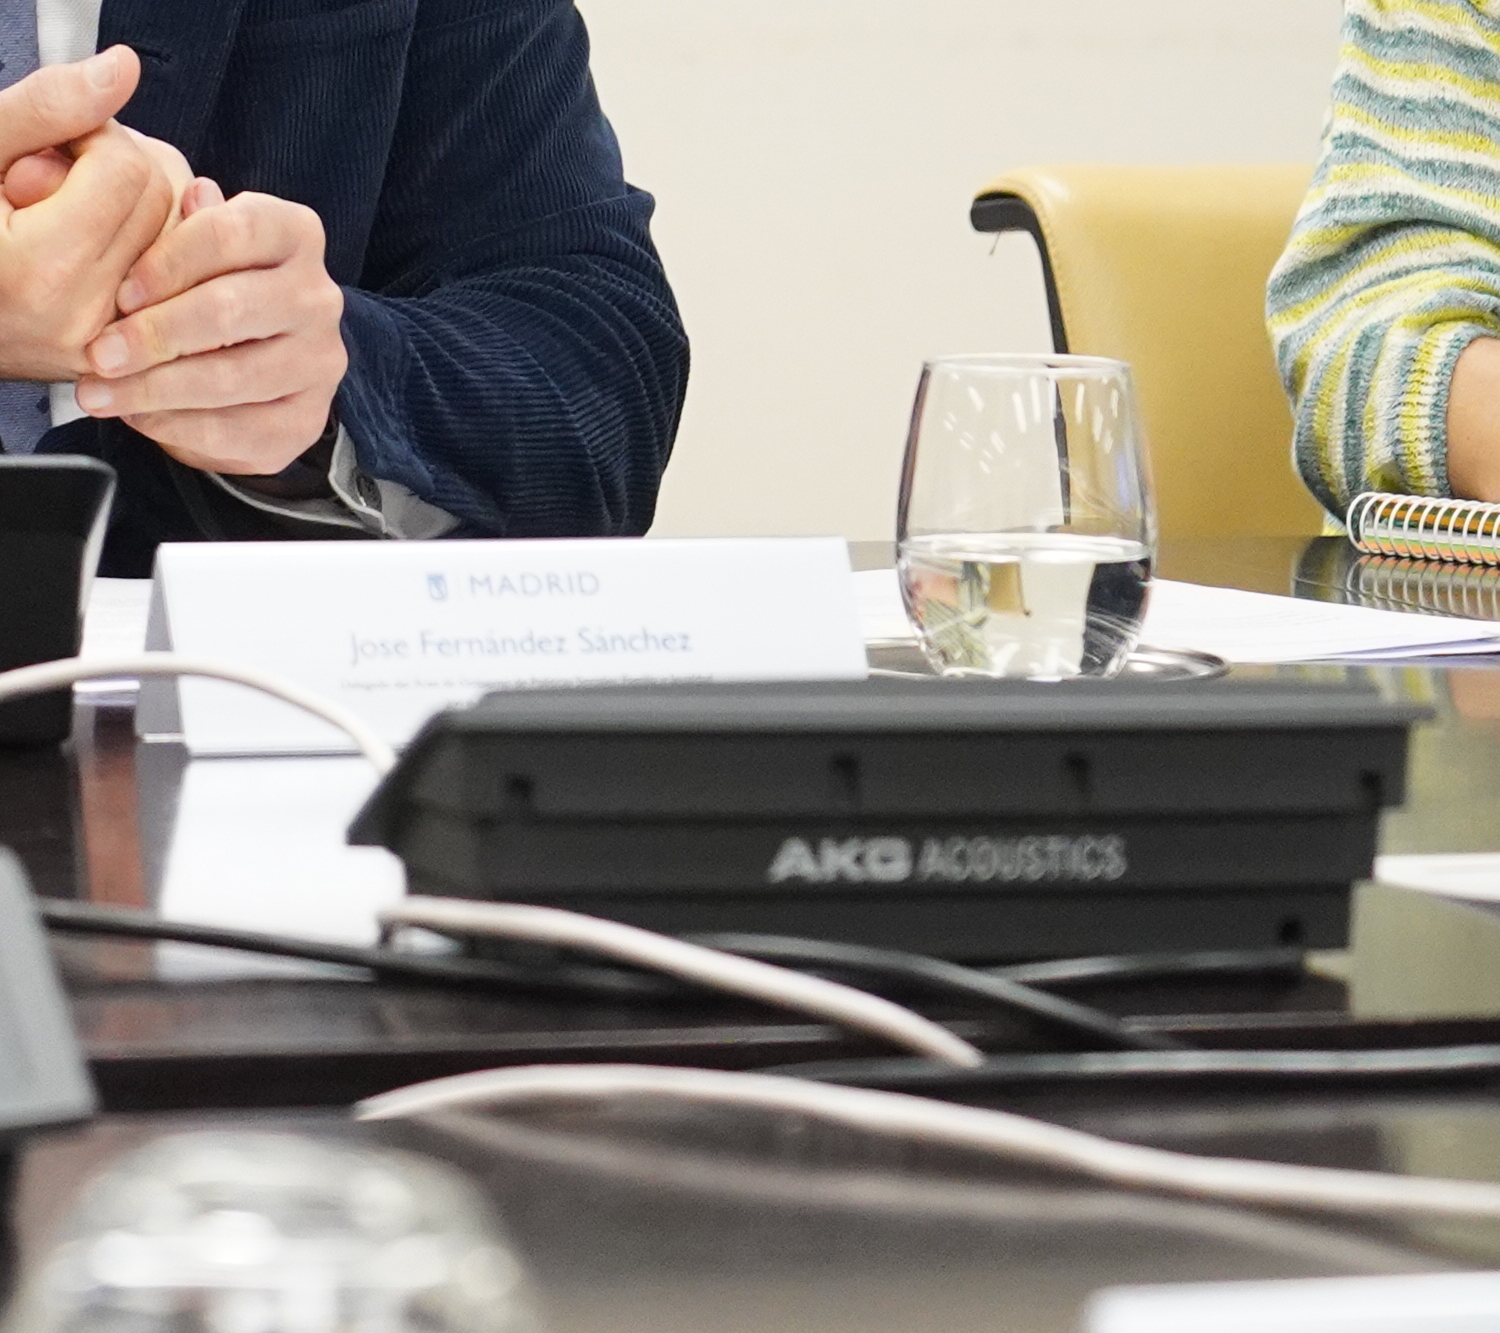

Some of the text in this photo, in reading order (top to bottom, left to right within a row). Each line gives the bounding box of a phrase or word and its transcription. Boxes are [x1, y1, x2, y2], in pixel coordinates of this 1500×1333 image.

[467, 570, 602, 598] MADRID
[418, 627, 569, 659] Fernández
[576, 624, 694, 656] Sánchez
[769, 834, 1127, 883] AKG ACOUSTICS
